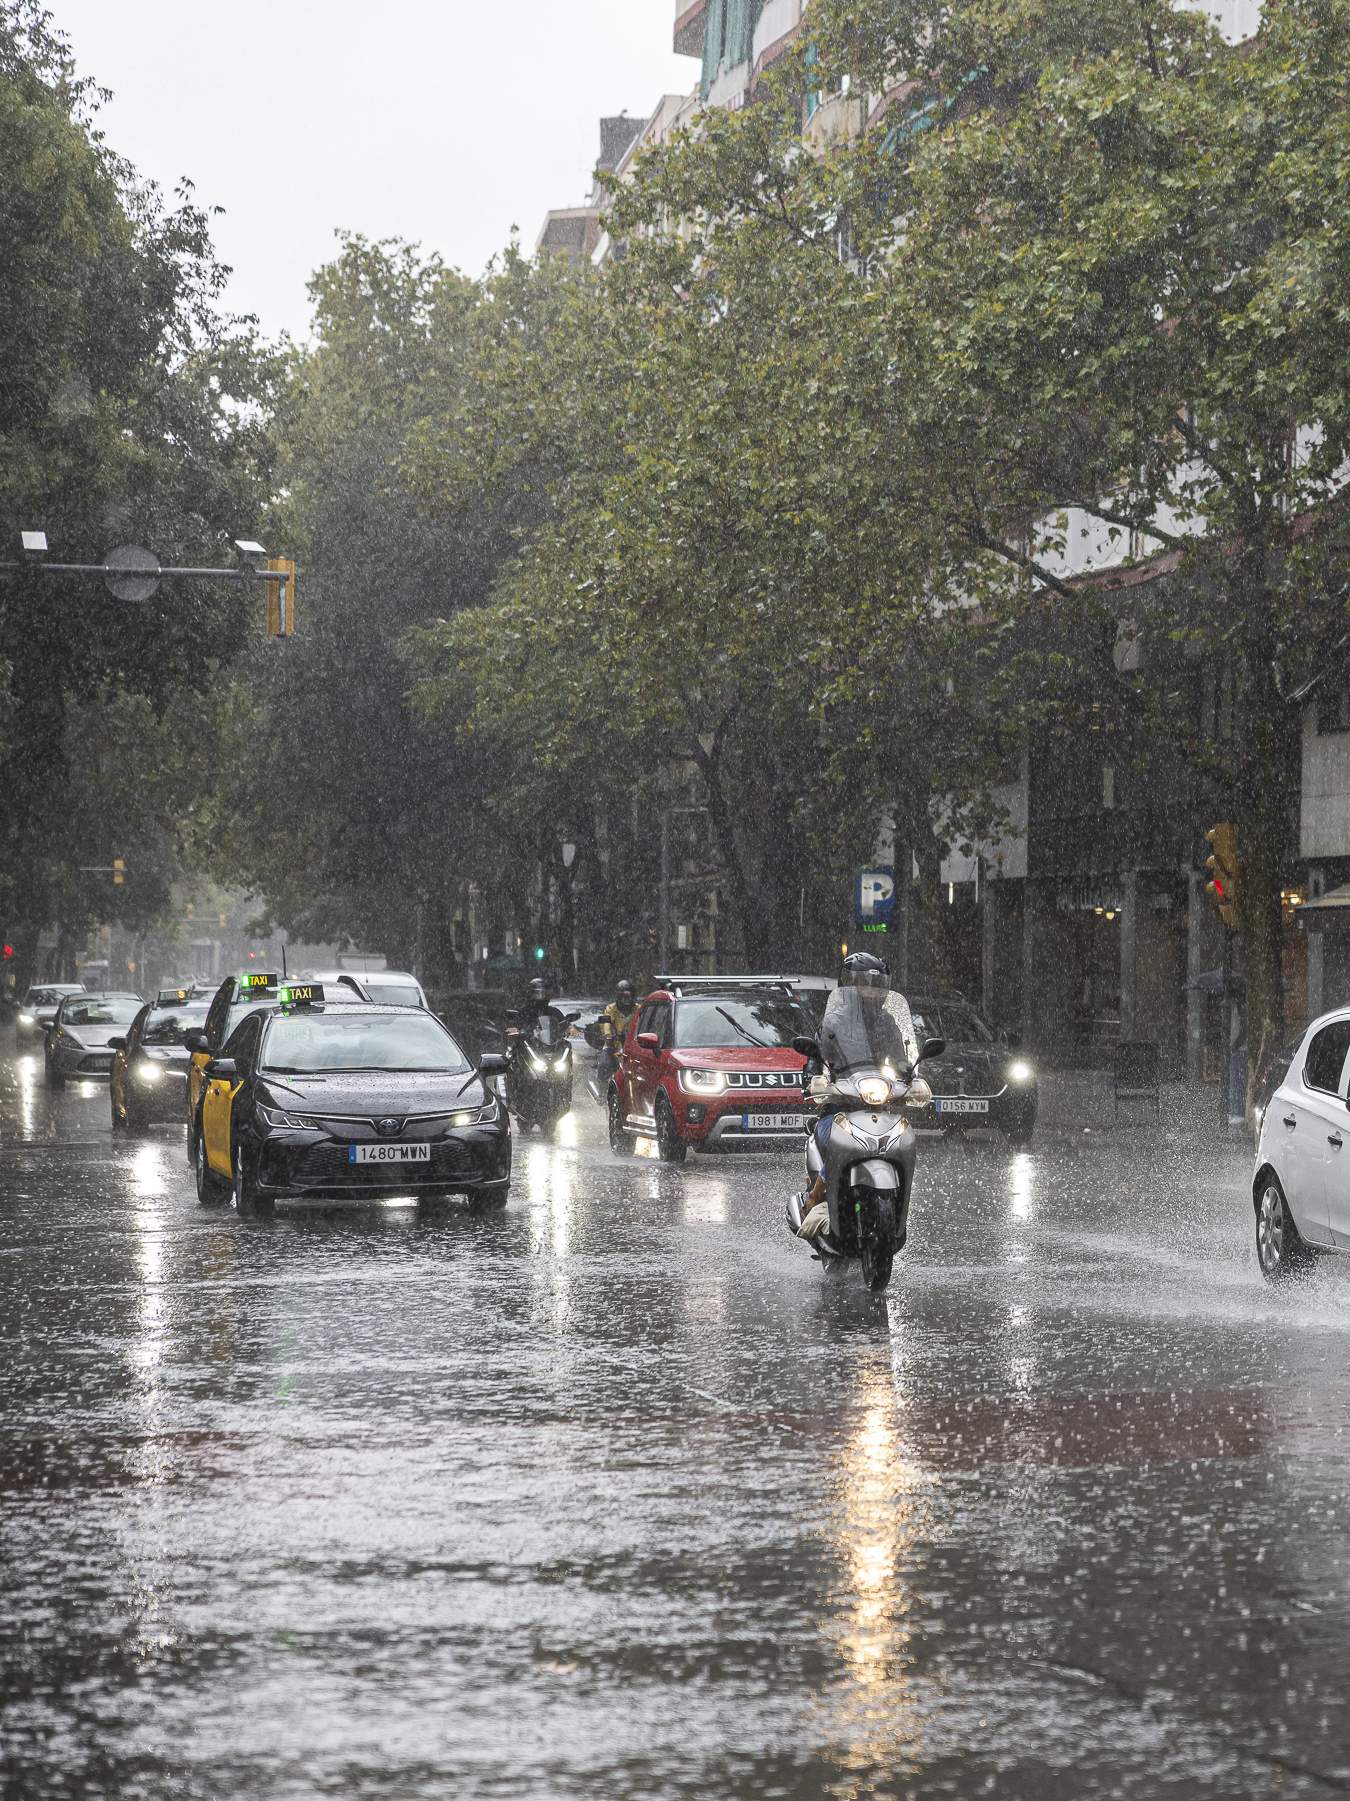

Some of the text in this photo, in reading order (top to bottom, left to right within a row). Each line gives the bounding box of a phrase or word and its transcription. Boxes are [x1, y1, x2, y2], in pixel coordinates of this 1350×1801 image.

[861, 873, 894, 916] P
[250, 975, 268, 986] TAXI
[289, 987, 312, 999] TAXI
[752, 1116, 800, 1126] 1981 MDF
[362, 1146, 427, 1160] 1480 MWN
